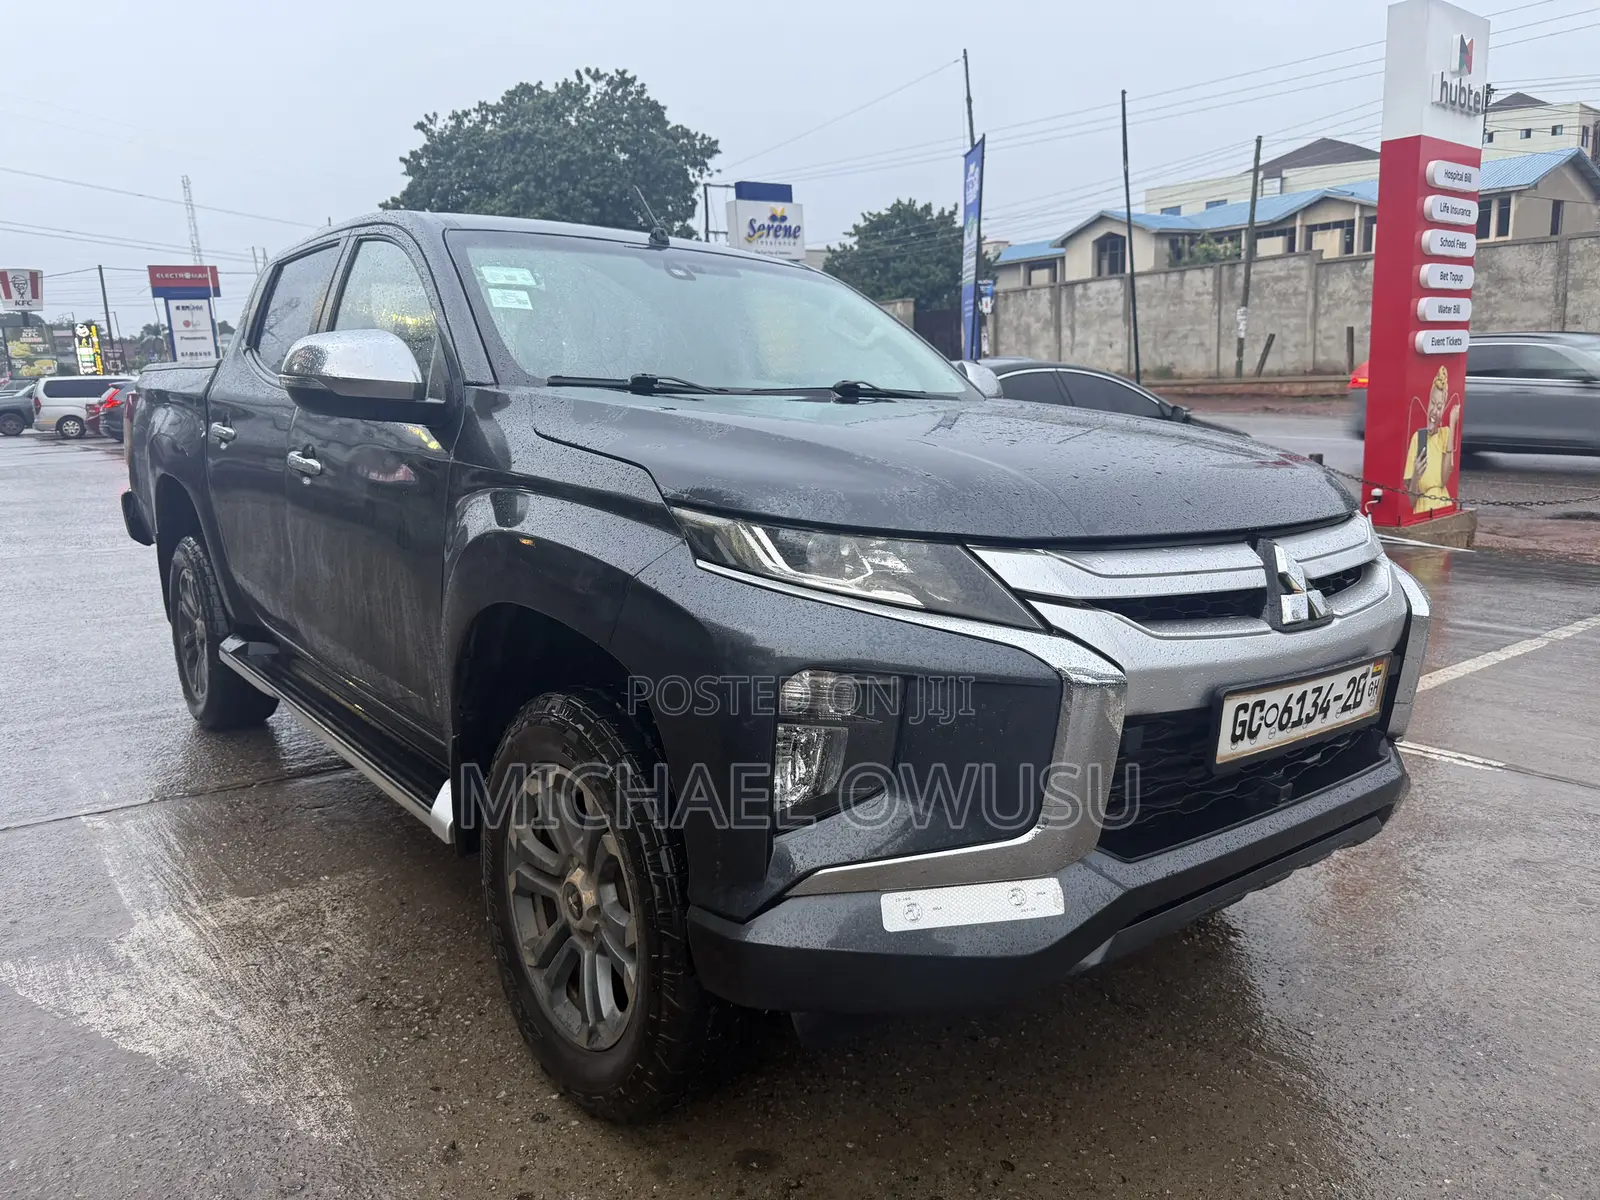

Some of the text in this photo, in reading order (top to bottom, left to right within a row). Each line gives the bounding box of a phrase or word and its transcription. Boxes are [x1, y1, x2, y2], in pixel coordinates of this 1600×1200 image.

[1440, 71, 1485, 113] hubtel
[1444, 168, 1472, 183] Hospital Bill
[1440, 202, 1471, 217] Life Insurance
[747, 218, 801, 239] Serene
[1440, 237, 1467, 249] School Fees
[1440, 271, 1463, 284] Bet Topup
[1438, 304, 1461, 314] Water Bill
[1431, 336, 1462, 346] Event Tickets
[1368, 679, 1380, 697] GH
[1230, 698, 1266, 744] GC
